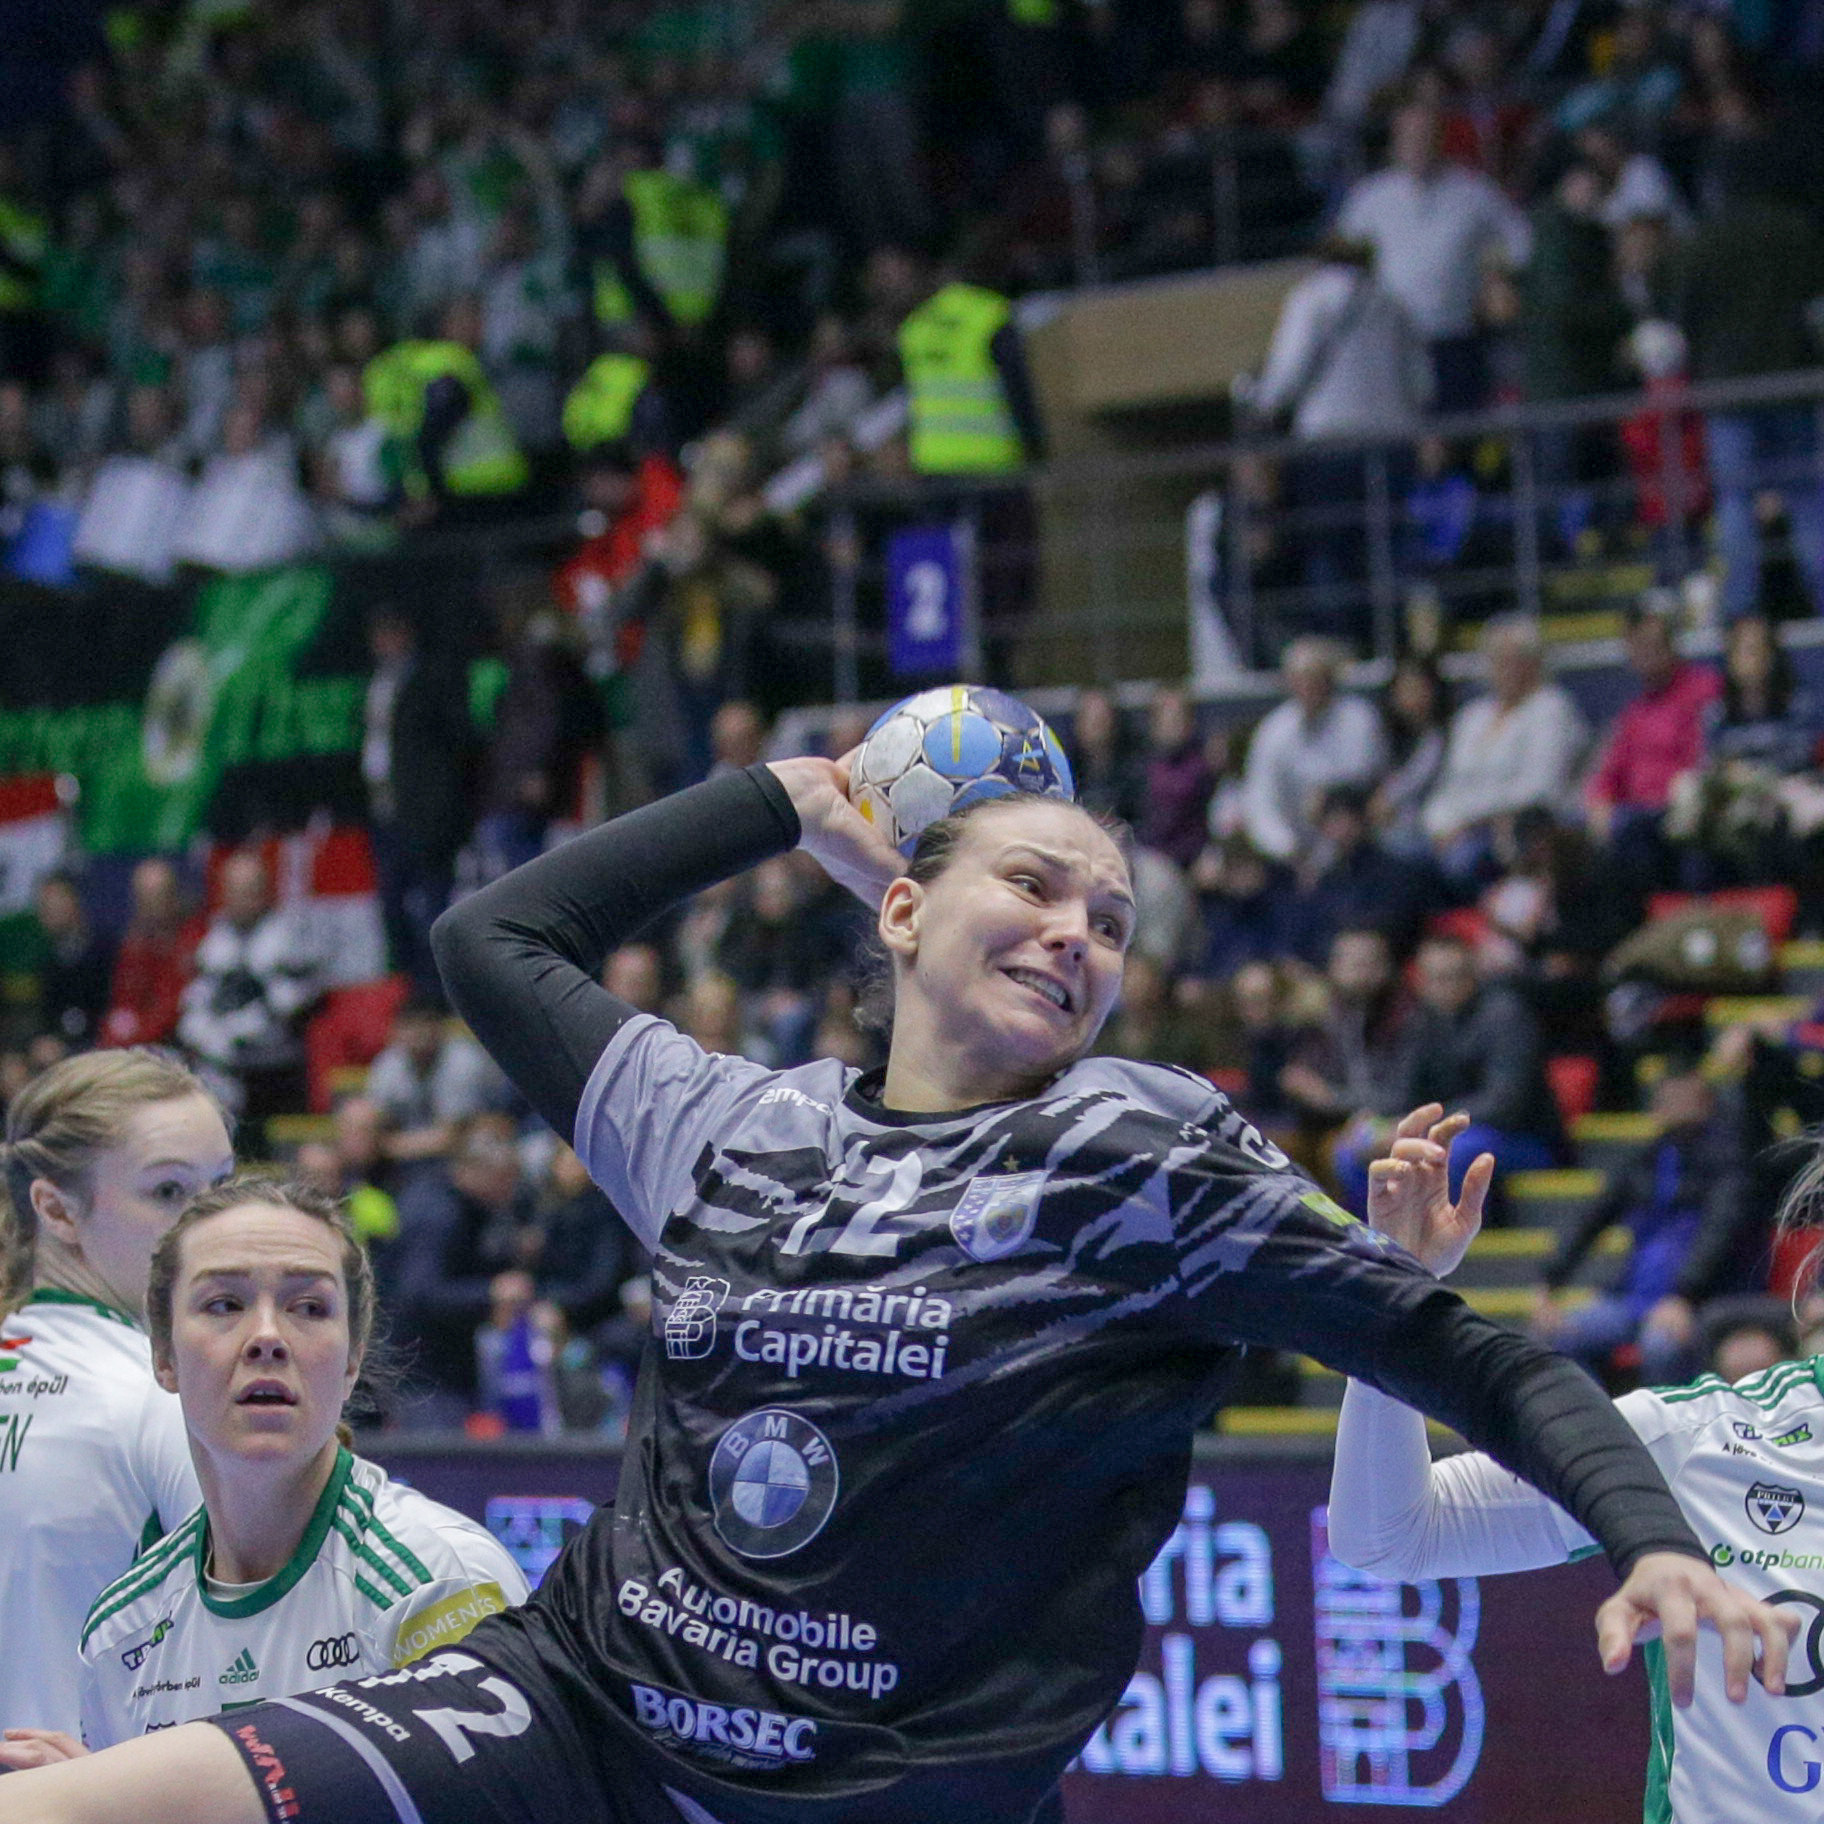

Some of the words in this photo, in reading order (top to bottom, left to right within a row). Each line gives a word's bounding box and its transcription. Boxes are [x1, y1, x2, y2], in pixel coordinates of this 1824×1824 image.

[758, 1087, 833, 1116] empa
[734, 1320, 949, 1379] Capitalei
[725, 1415, 829, 1467] BMW
[658, 1567, 877, 1651] Automobile
[617, 1580, 759, 1668] Bavaria
[768, 1645, 899, 1699] Group
[315, 1684, 412, 1743] Kempa
[631, 1684, 818, 1764] BORSEC
